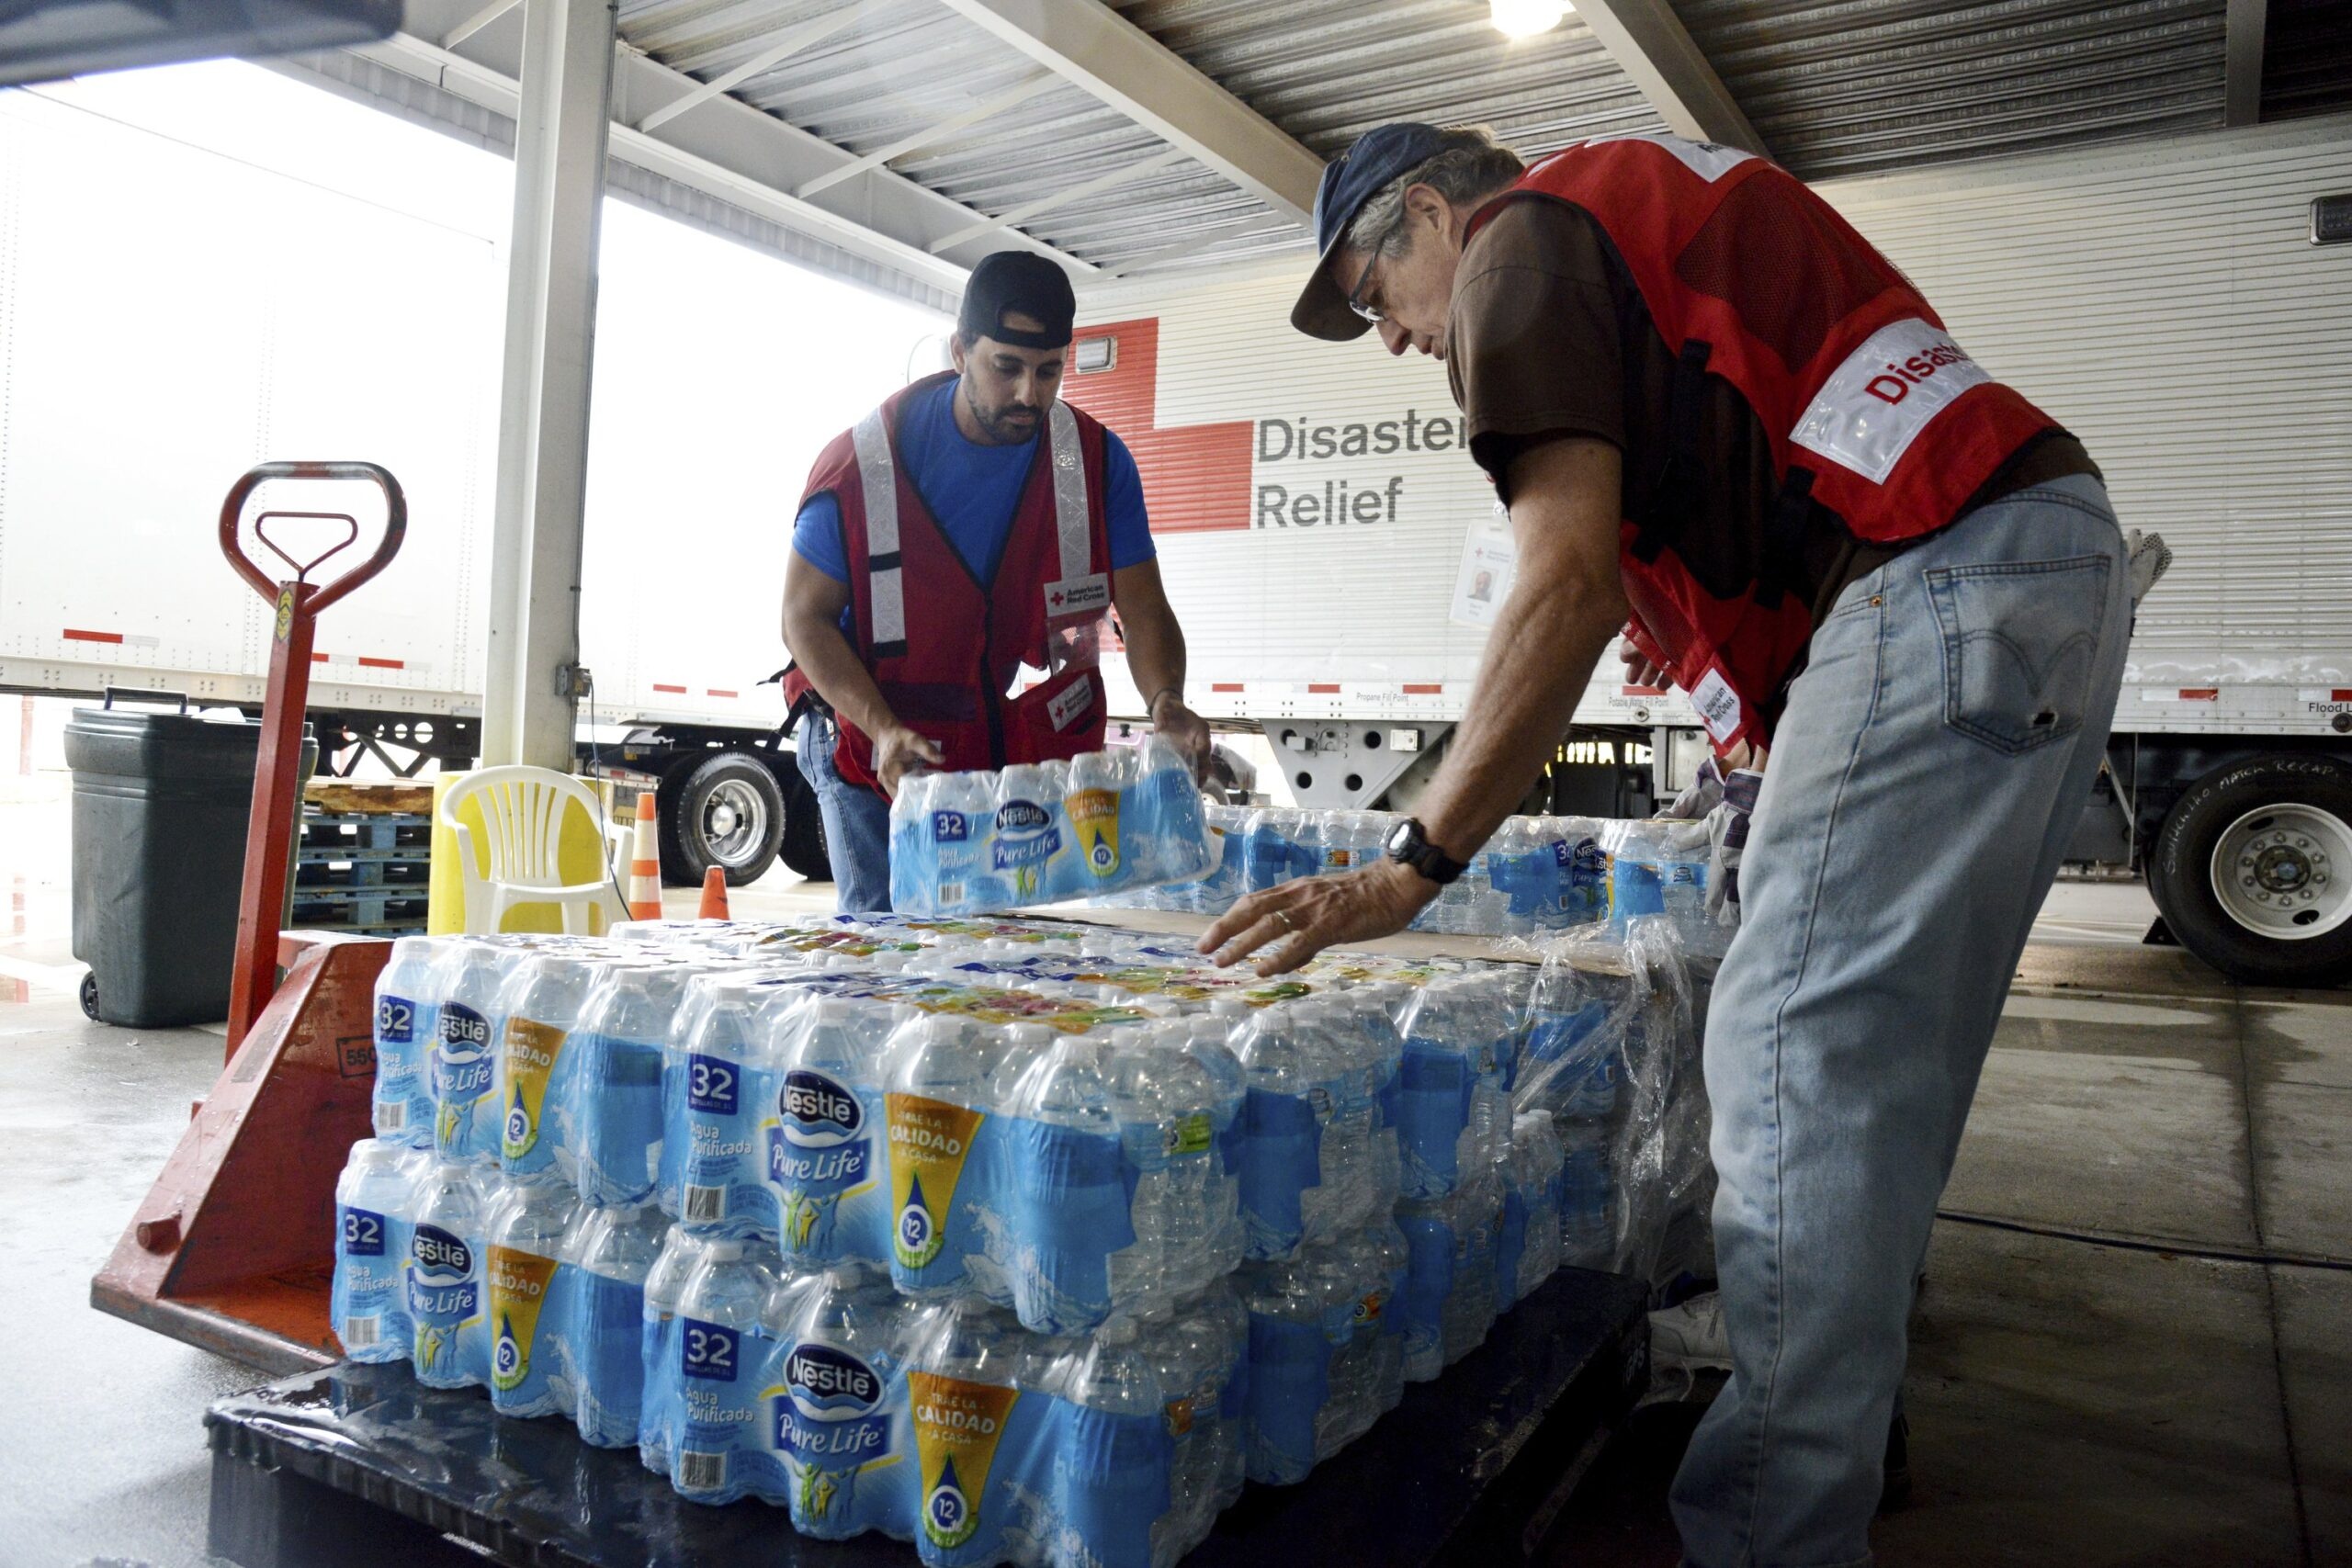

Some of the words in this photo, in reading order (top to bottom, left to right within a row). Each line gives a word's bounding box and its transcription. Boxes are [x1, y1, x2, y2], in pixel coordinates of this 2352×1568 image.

[1864, 341, 1969, 405] Disast
[1258, 477, 1403, 529] Relief
[1067, 585, 1103, 596] American
[1067, 595, 1082, 604] Red
[1083, 592, 1104, 601] Cross
[1382, 692, 1391, 702] Fill
[1393, 693, 1408, 702] Point
[1704, 687, 1726, 713] American
[1718, 696, 1735, 715] Cross
[2309, 702, 2342, 713] Flood
[938, 813, 963, 836] 32
[996, 845, 1027, 864] Pure
[1030, 834, 1057, 856] Life
[1557, 844, 1570, 861] 3
[379, 1001, 411, 1031] 32
[458, 1064, 490, 1091] Life
[692, 1063, 732, 1101] 32
[691, 1121, 719, 1140] Agua
[890, 1124, 961, 1156] CALIDAD
[692, 1137, 753, 1157] Purificada
[773, 1144, 812, 1180] Pure
[813, 1149, 861, 1181] Life
[345, 1213, 379, 1244] 32
[907, 1217, 922, 1239] 12
[436, 1289, 474, 1314] Life
[500, 1348, 512, 1366] 12
[687, 1328, 732, 1367] 32
[685, 1386, 718, 1405] Agua
[931, 1393, 958, 1407] TRAE
[962, 1399, 977, 1410] LA
[687, 1403, 754, 1424] Purificada
[916, 1404, 995, 1435] CALIDAD
[779, 1414, 827, 1454] Pure
[830, 1423, 881, 1454] Life
[942, 1431, 972, 1445] CASA
[939, 1498, 956, 1519] 12
